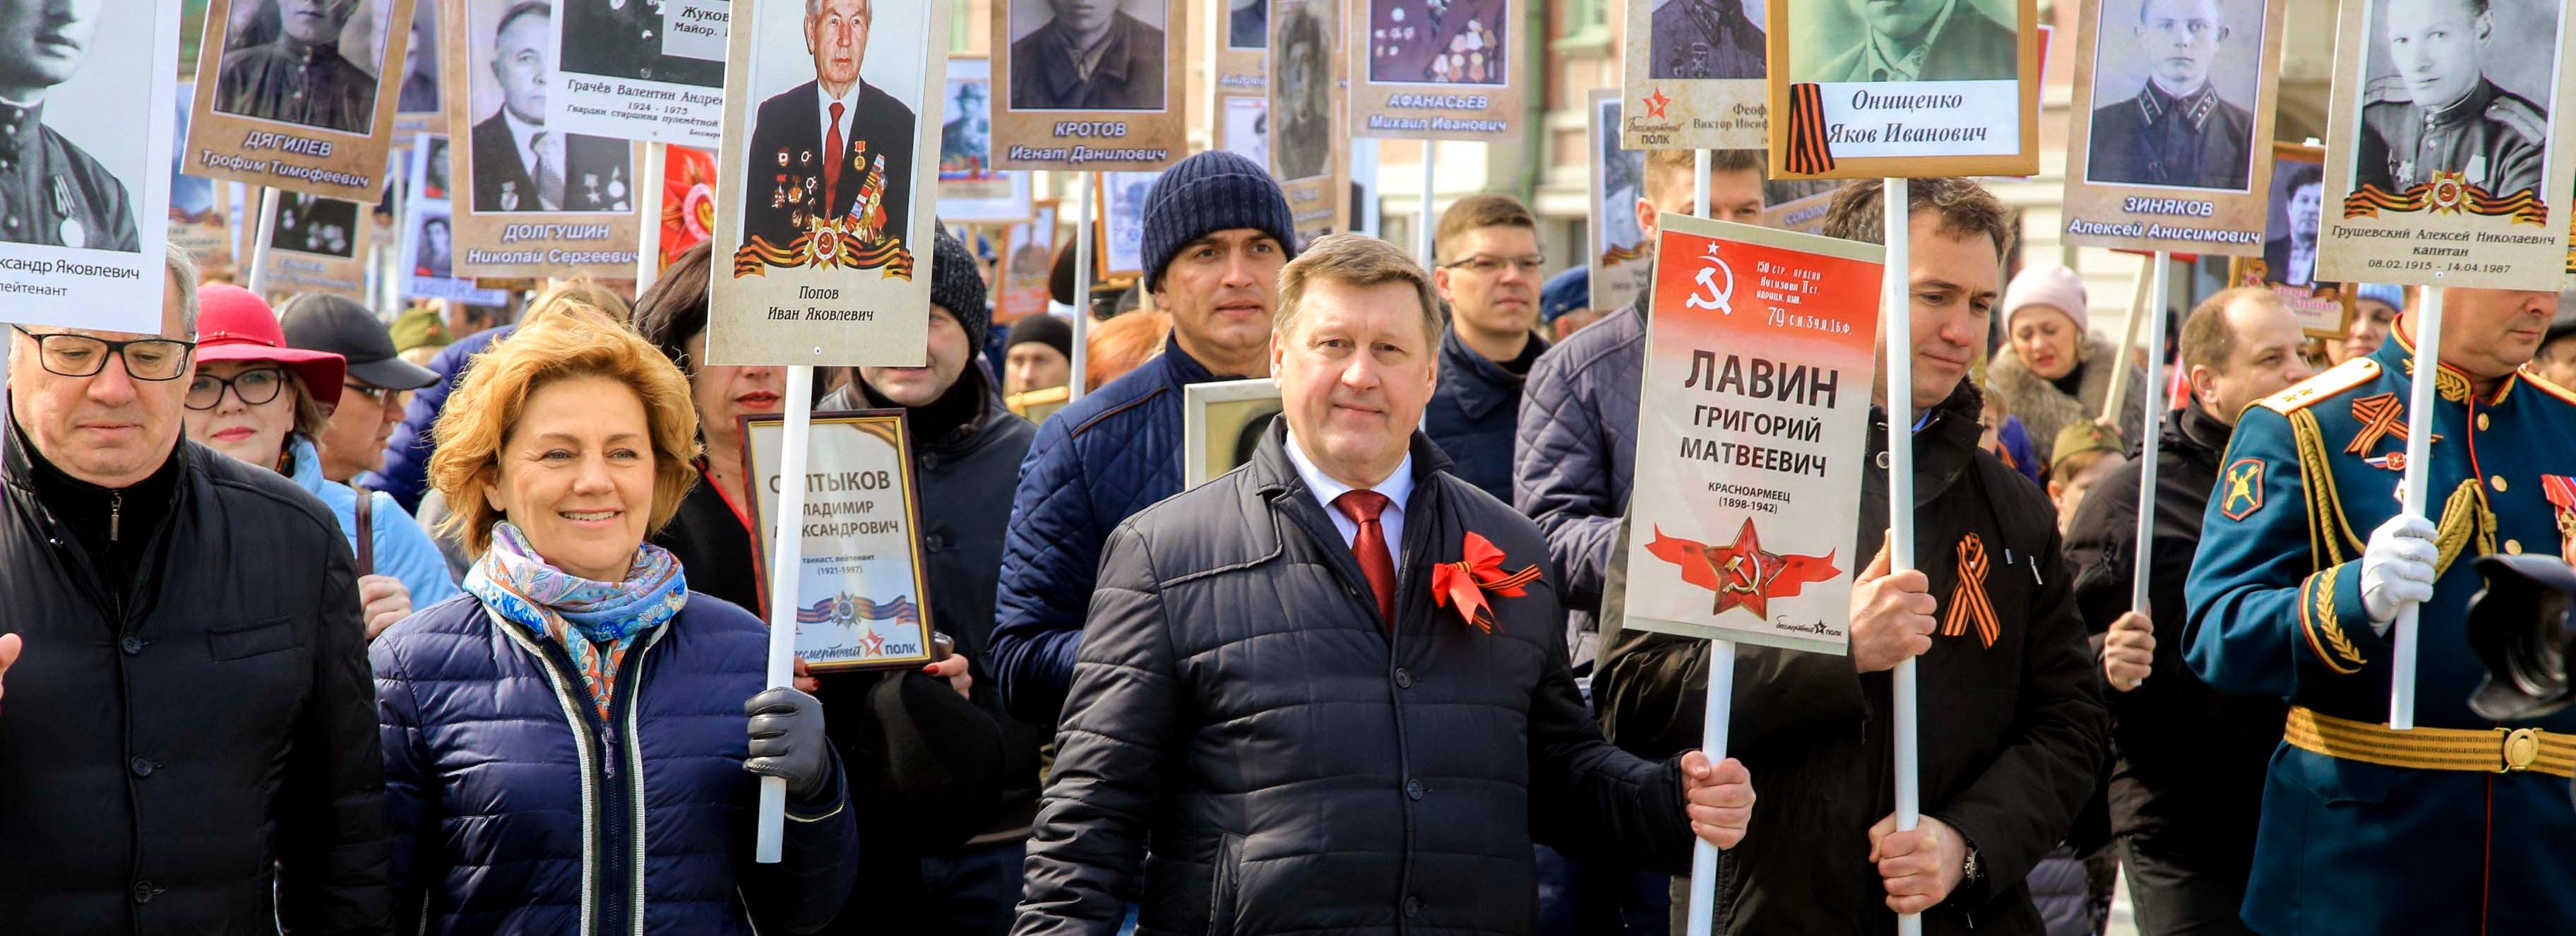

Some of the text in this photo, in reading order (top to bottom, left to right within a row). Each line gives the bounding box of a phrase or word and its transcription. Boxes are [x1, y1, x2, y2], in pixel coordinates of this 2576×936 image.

[674, 22, 717, 37] Майор.
[567, 78, 611, 94] Грачёв
[617, 84, 676, 100] Валентин
[628, 102, 651, 111] 1924
[1387, 93, 1489, 109] АФАНАСЬЕВ
[1852, 90, 1963, 114] Онищенко
[566, 105, 718, 127] Гвардии старшина пулемётной
[1733, 103, 1768, 118] Феоф
[1054, 122, 1127, 137] КРОТОВ
[1368, 114, 1507, 132] Михаил Иванович
[1694, 119, 1732, 131] Виктор
[1829, 122, 1988, 143] Яков Иванович
[243, 131, 333, 158] ДЯГИЛЕВ
[1009, 145, 1167, 163] Игнат Данилович
[202, 149, 370, 188] Трофим Тимофеевич
[2123, 196, 2214, 217] ЗИНЯКОВ
[501, 224, 611, 243] ДОЛГУШИН
[2068, 218, 2260, 244] Алексей Анисимович
[2332, 225, 2556, 245] Грушевский Алексей Николаевич
[467, 248, 543, 264] Николай
[2412, 247, 2469, 257] капитан
[56, 259, 140, 280] Яковлевич
[1757, 261, 1770, 273] 150
[2368, 259, 2433, 271] 08.02.1915
[2447, 262, 2511, 273] 14.04.1987
[799, 285, 839, 300] Попов
[768, 307, 874, 321] Иван Яковлевич
[1767, 307, 1785, 328] 79
[1685, 349, 1838, 409] ЛАВИН
[1693, 405, 1821, 443] ГРИГОРИЙ
[1680, 437, 1827, 478] МАТВЕЕВИЧ
[769, 470, 891, 494] СТЫКОВ
[1708, 481, 1791, 504] КРАСНОАРМЕЕЦ
[803, 500, 874, 518] ЛАДИМИР
[1719, 497, 1778, 515] (1898-1942)
[774, 520, 899, 538] КСАНДРОВИЧ
[835, 554, 875, 563] лейтенант
[818, 565, 863, 576] (1921-1997)
[794, 643, 862, 662] ссмертный
